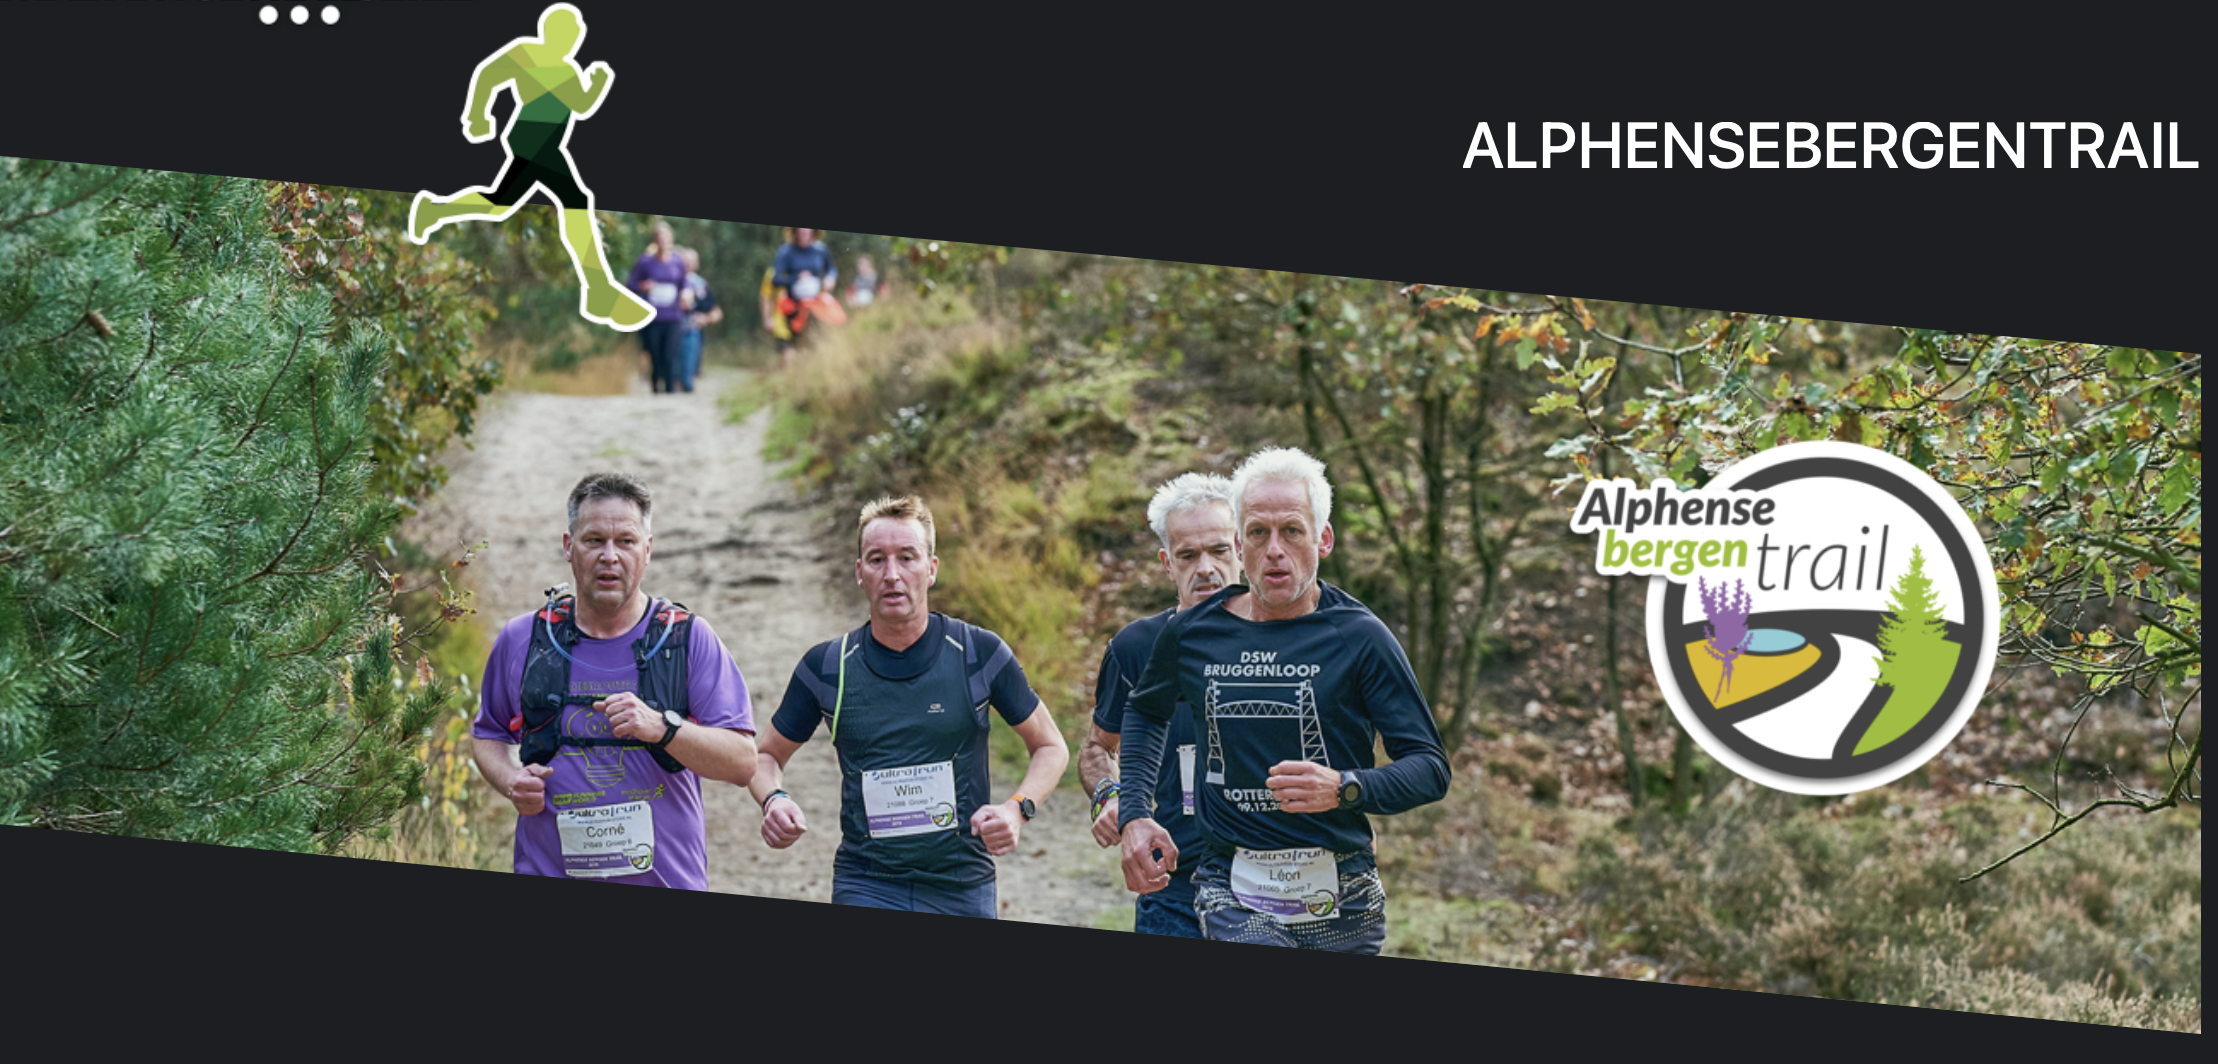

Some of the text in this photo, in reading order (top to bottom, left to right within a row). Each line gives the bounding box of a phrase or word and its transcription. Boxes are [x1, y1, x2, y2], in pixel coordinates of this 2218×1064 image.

[1240, 651, 1278, 663] DSW
[1204, 664, 1321, 677] BRUGGENLOOP
[894, 784, 923, 797] Wim
[586, 823, 625, 838] Corné
[1269, 869, 1301, 882] Léon
